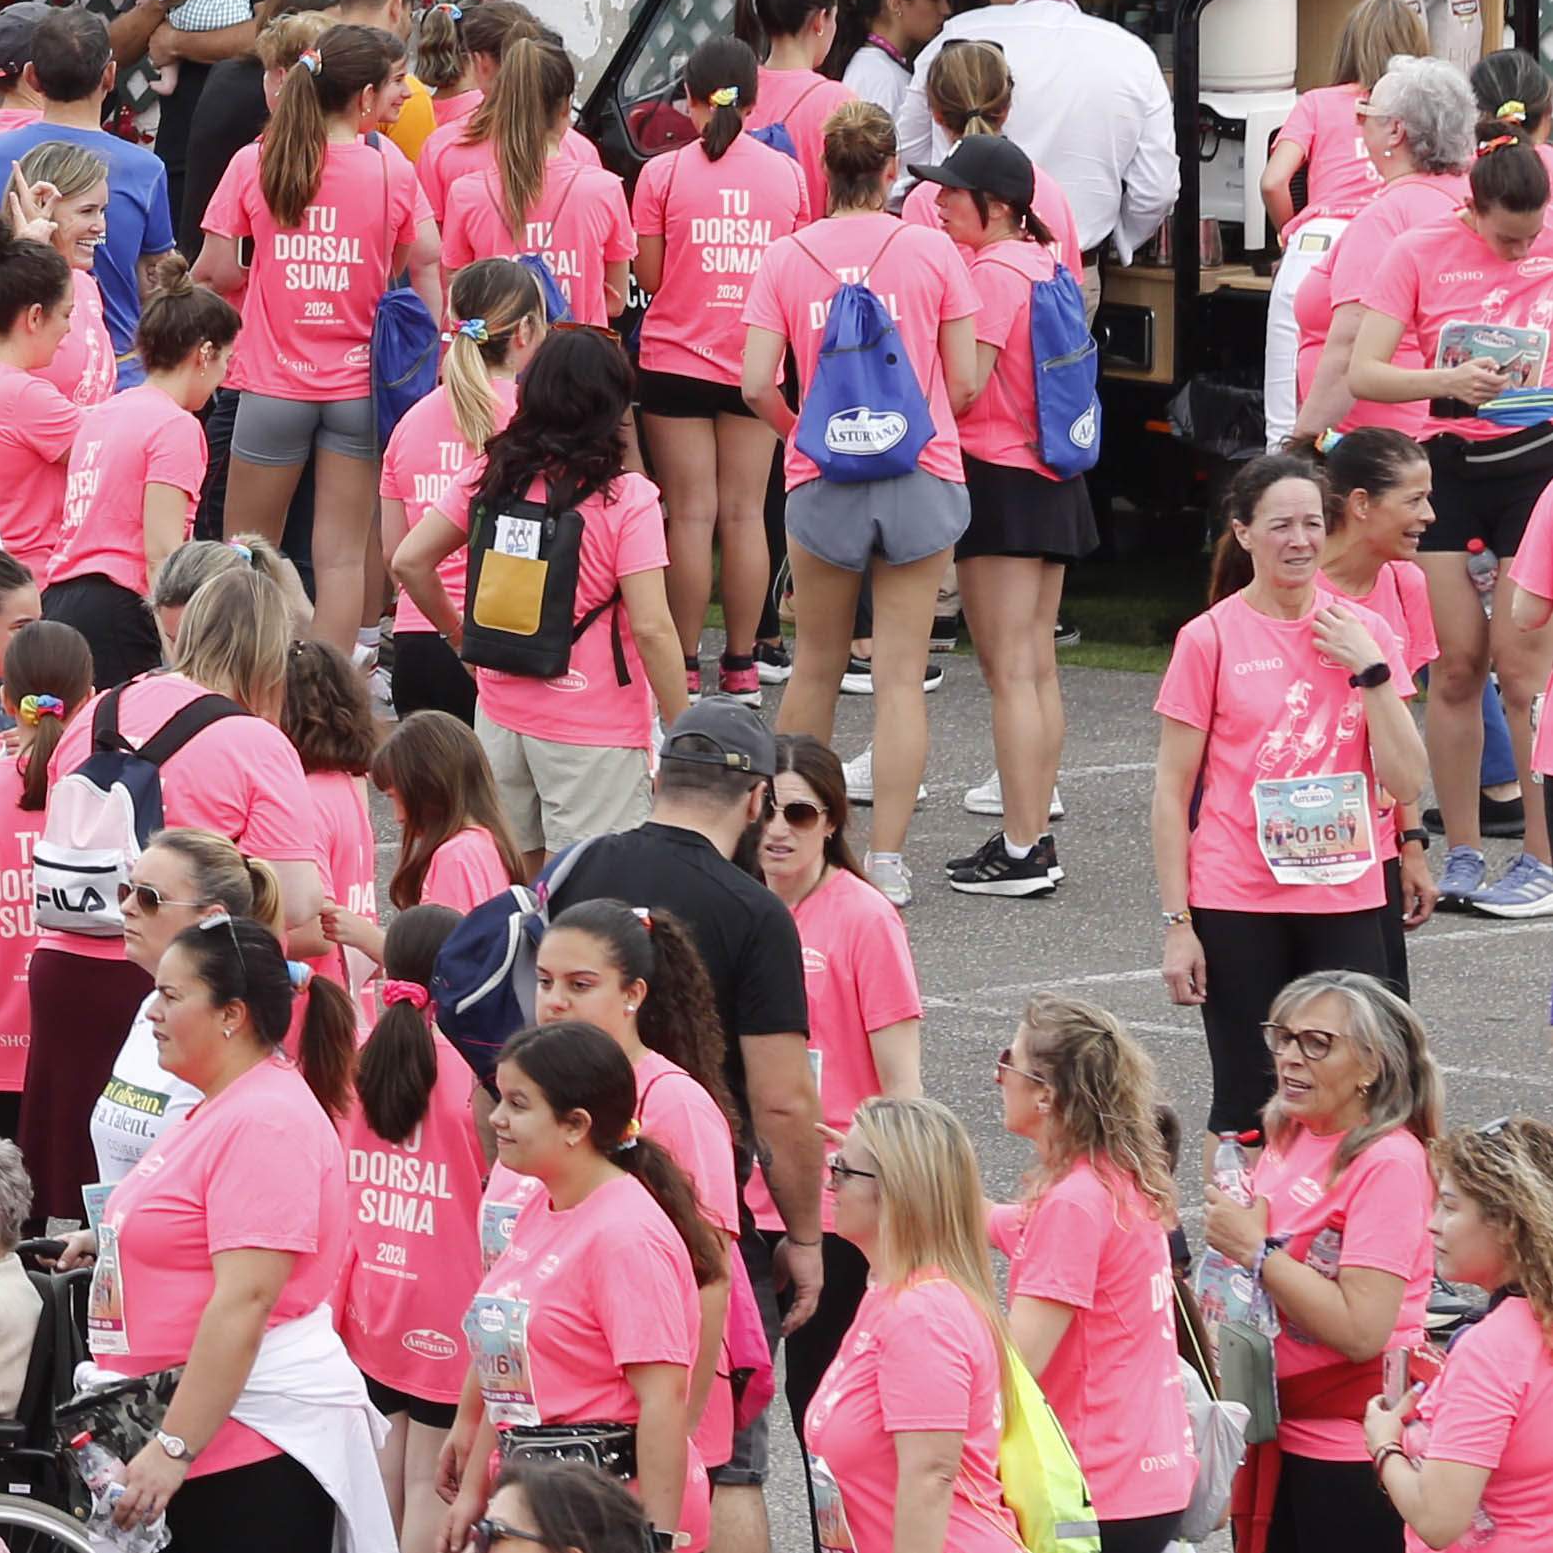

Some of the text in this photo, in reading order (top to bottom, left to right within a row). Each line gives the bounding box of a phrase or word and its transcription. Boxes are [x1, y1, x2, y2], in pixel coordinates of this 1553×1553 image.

[719, 189, 749, 216] TU
[306, 206, 336, 233] TU
[691, 218, 772, 245] DORSAL
[526, 222, 552, 248] TU
[275, 234, 364, 264] DORSAL
[702, 247, 762, 275] SUMA
[285, 263, 351, 292] SUMA
[1439, 271, 1483, 284] OYSHO
[717, 284, 744, 300] 2024
[305, 302, 335, 316] 2024
[827, 424, 901, 445] ASTURIANA
[439, 442, 464, 471] TU
[414, 475, 457, 502] DOR
[1235, 657, 1283, 676] OYSHO
[1296, 824, 1337, 844] 016
[36, 886, 106, 913] FILA
[108, 1105, 156, 1139] Talent.
[349, 1149, 453, 1200] DORSAL
[358, 1189, 434, 1236] SUMA
[408, 1336, 453, 1354] ASTURIANA
